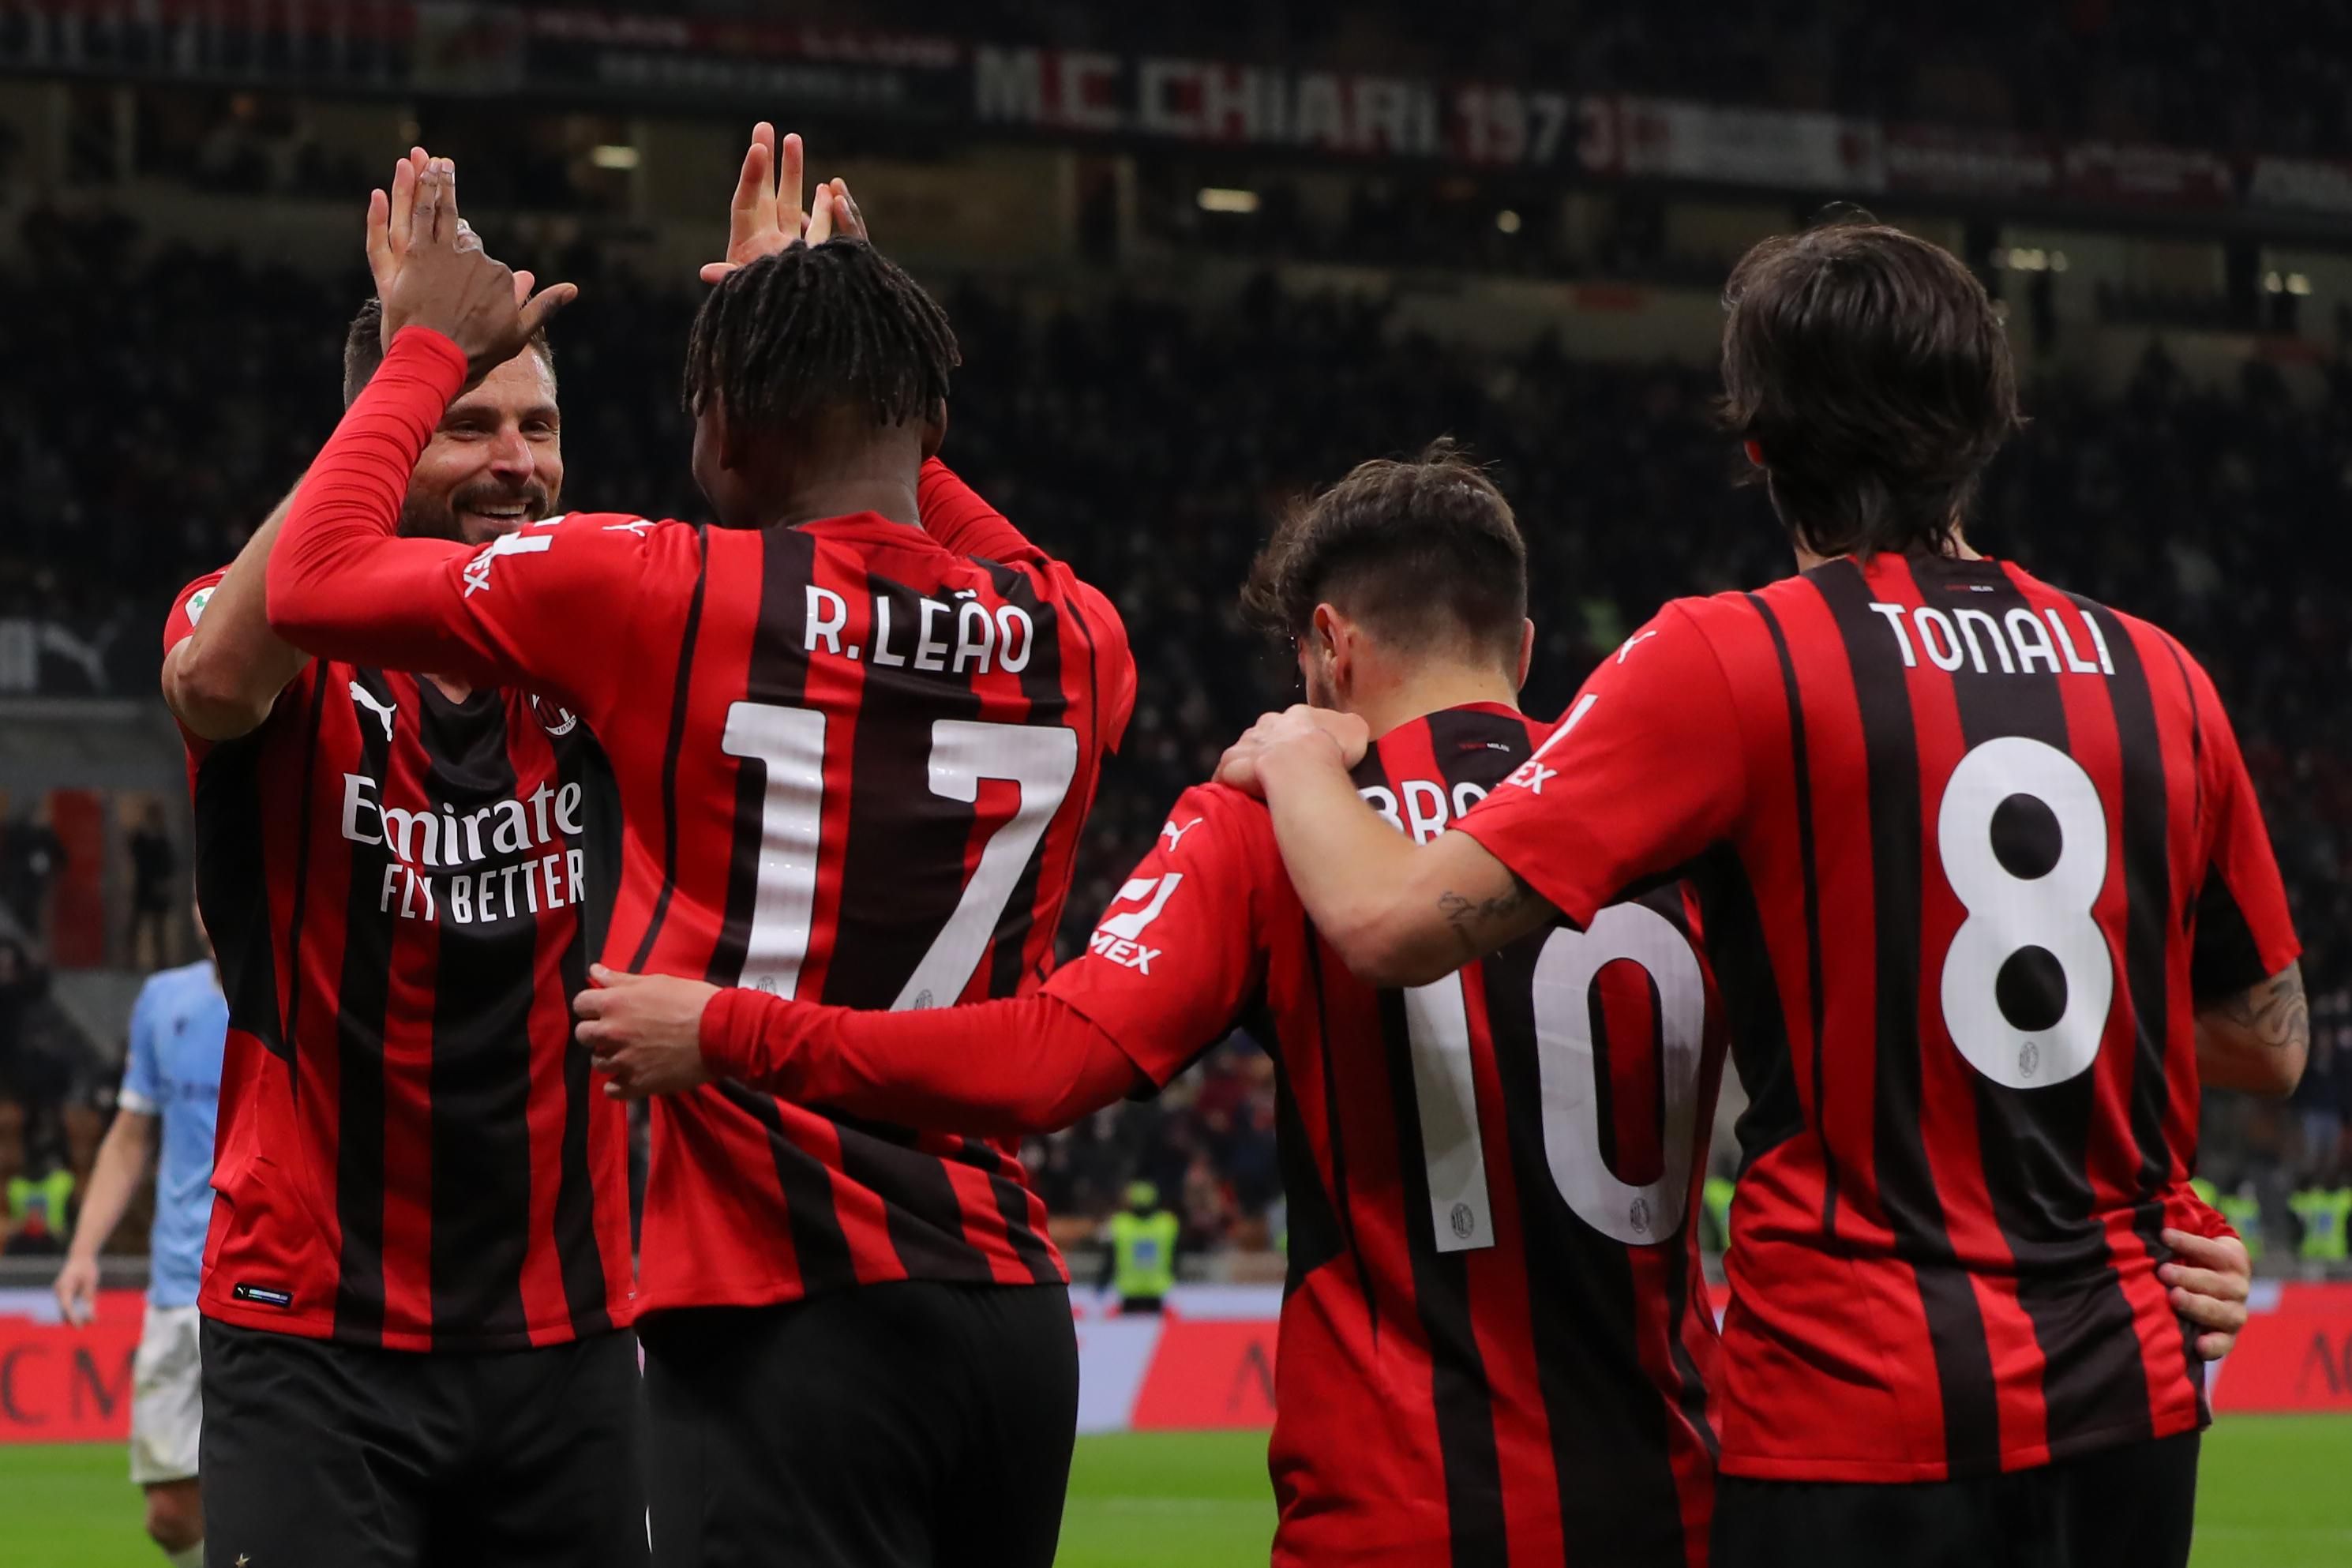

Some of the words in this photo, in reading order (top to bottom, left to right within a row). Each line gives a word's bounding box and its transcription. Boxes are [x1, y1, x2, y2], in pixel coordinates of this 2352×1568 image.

[804, 585, 1033, 673] R.LEÃO
[1868, 602, 2116, 674] TONALI
[342, 773, 583, 867] Emirate
[721, 701, 1078, 1013] 17
[380, 863, 433, 921] FLY
[451, 849, 585, 924] BETTER
[1938, 736, 2114, 1090] 8
[1403, 902, 1705, 1253] 10
